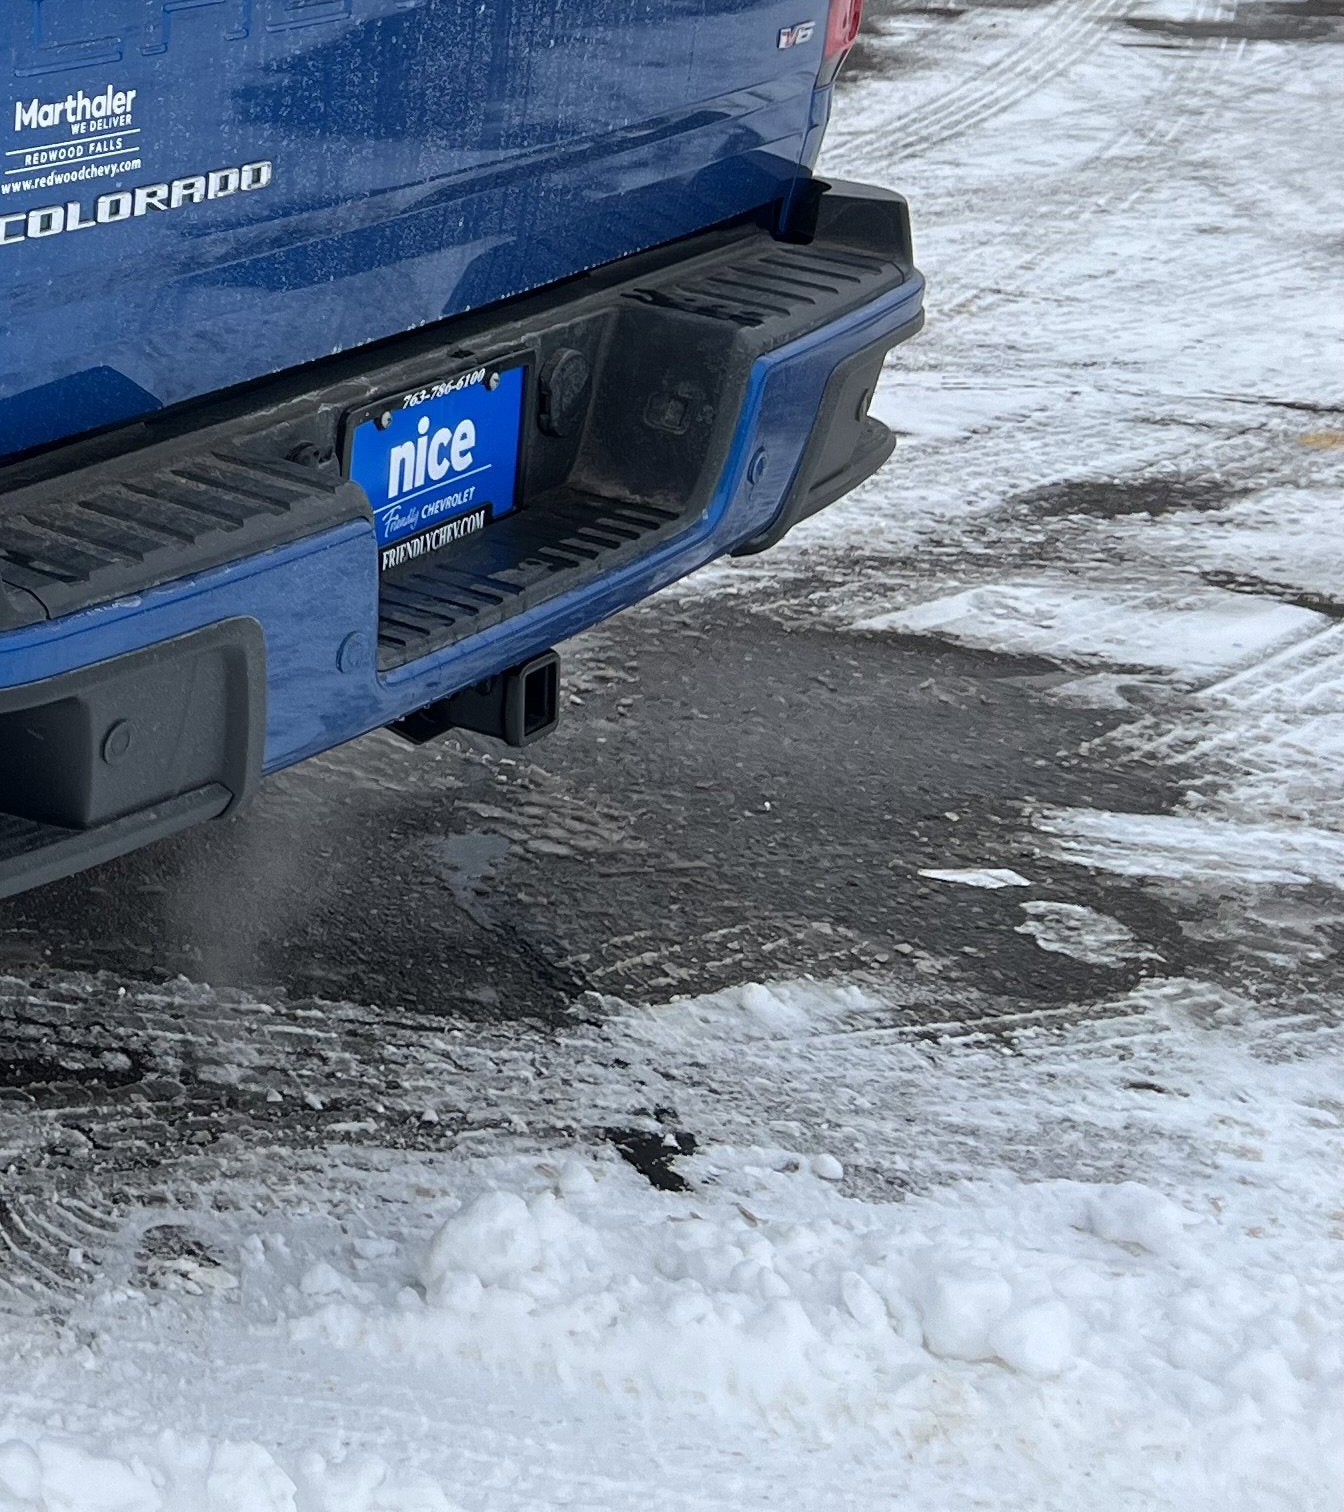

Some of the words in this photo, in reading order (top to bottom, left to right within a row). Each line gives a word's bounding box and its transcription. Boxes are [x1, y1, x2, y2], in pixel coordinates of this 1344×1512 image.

[778, 21, 816, 49] V6
[14, 84, 137, 131] Marthaler
[70, 122, 87, 135] WE
[89, 114, 132, 131] DELIVER
[24, 144, 83, 166] REDWOOD
[89, 138, 123, 154] FALLS
[1, 159, 142, 195] www.redwoodchevy.com
[388, 416, 476, 499] nice
[421, 486, 476, 518] CHEVROLET
[382, 510, 485, 571] FRIENDLYCHEV.COM
